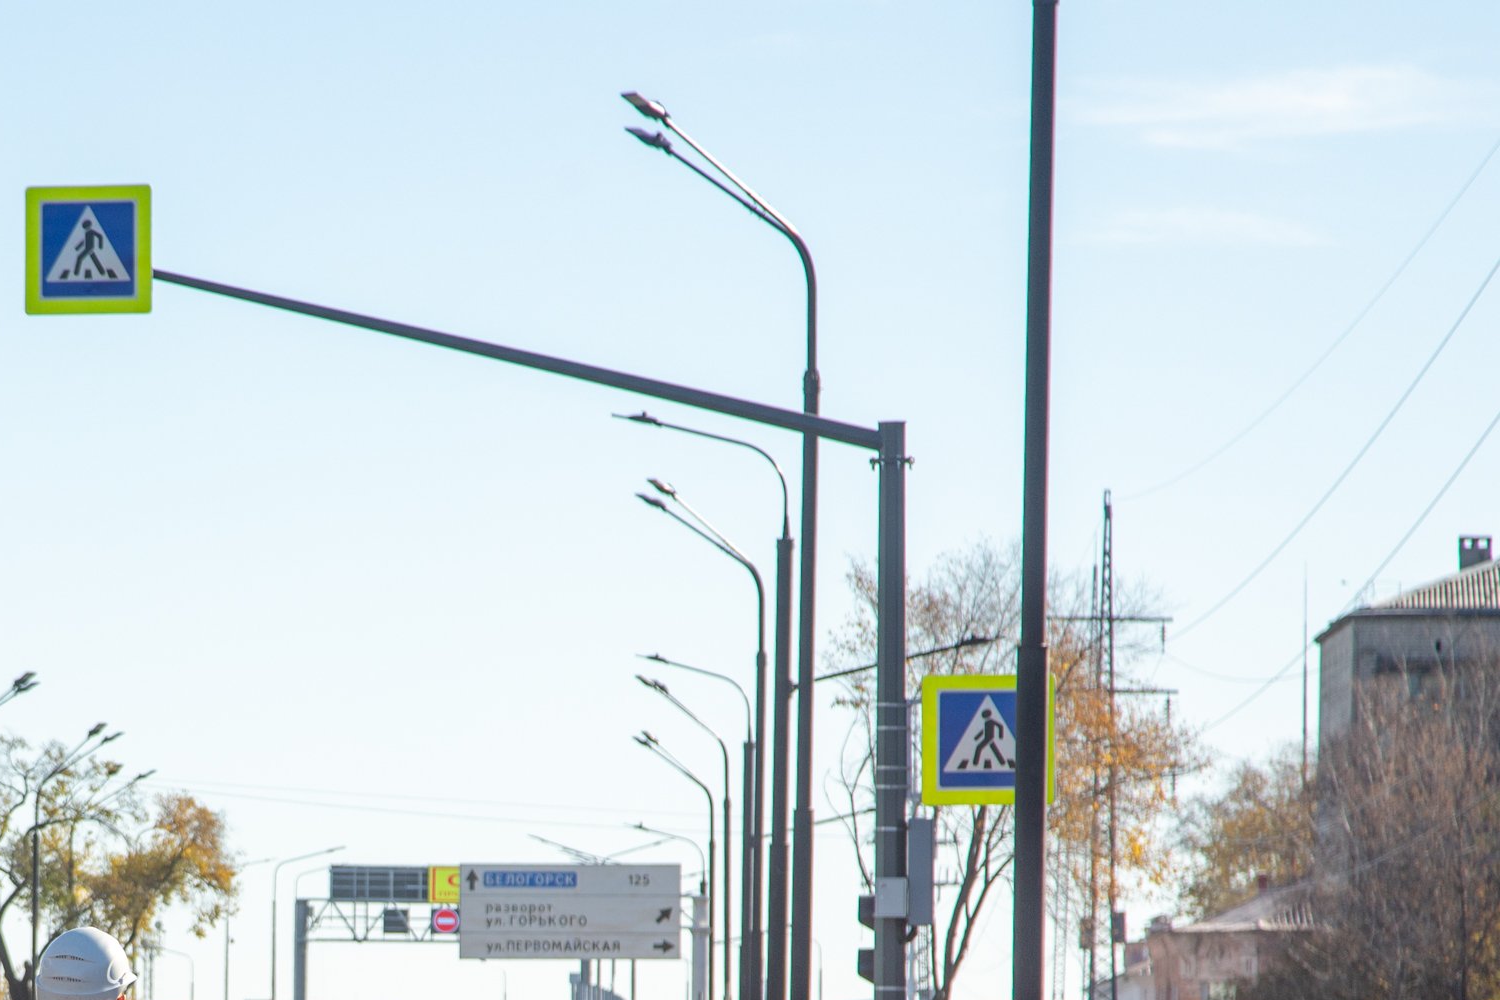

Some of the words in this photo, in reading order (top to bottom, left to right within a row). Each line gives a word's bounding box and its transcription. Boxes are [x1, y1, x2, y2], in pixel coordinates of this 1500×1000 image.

[486, 872, 574, 886] БЕЛОГОРСК
[629, 874, 650, 886] 125
[486, 904, 553, 914] разворот
[486, 917, 505, 928] ул.
[510, 915, 587, 927] ГОРЬКОГО
